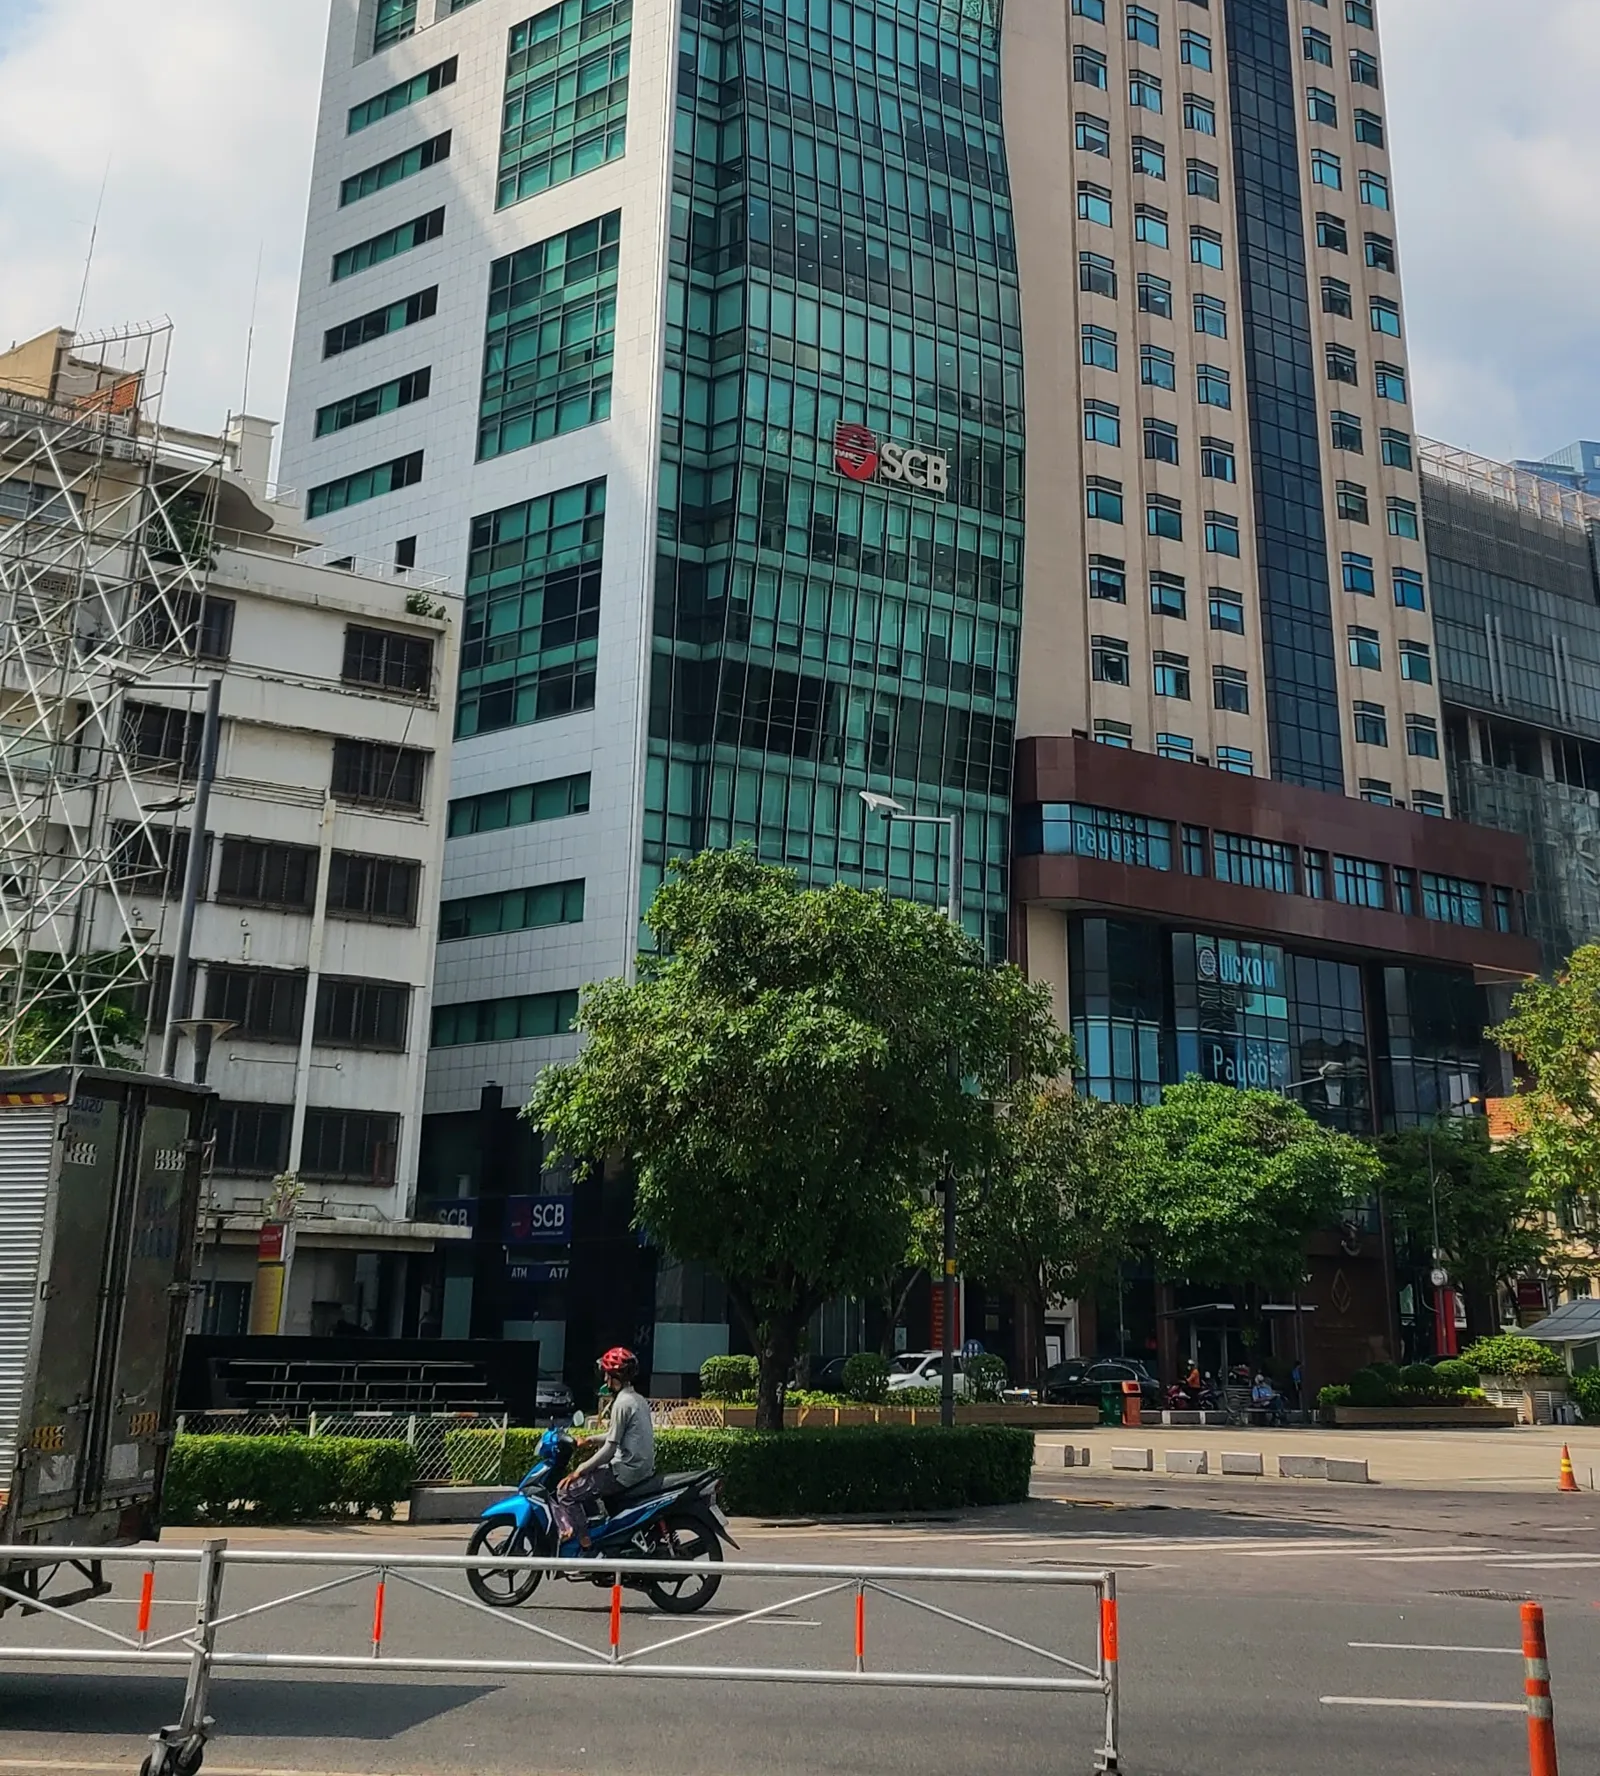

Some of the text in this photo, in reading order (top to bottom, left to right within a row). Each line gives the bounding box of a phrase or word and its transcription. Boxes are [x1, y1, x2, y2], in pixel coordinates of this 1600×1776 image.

[881, 442, 948, 494] SCB
[1212, 1043, 1268, 1091] Payoo
[532, 1203, 565, 1228] SCB
[510, 1267, 528, 1279] ATM
